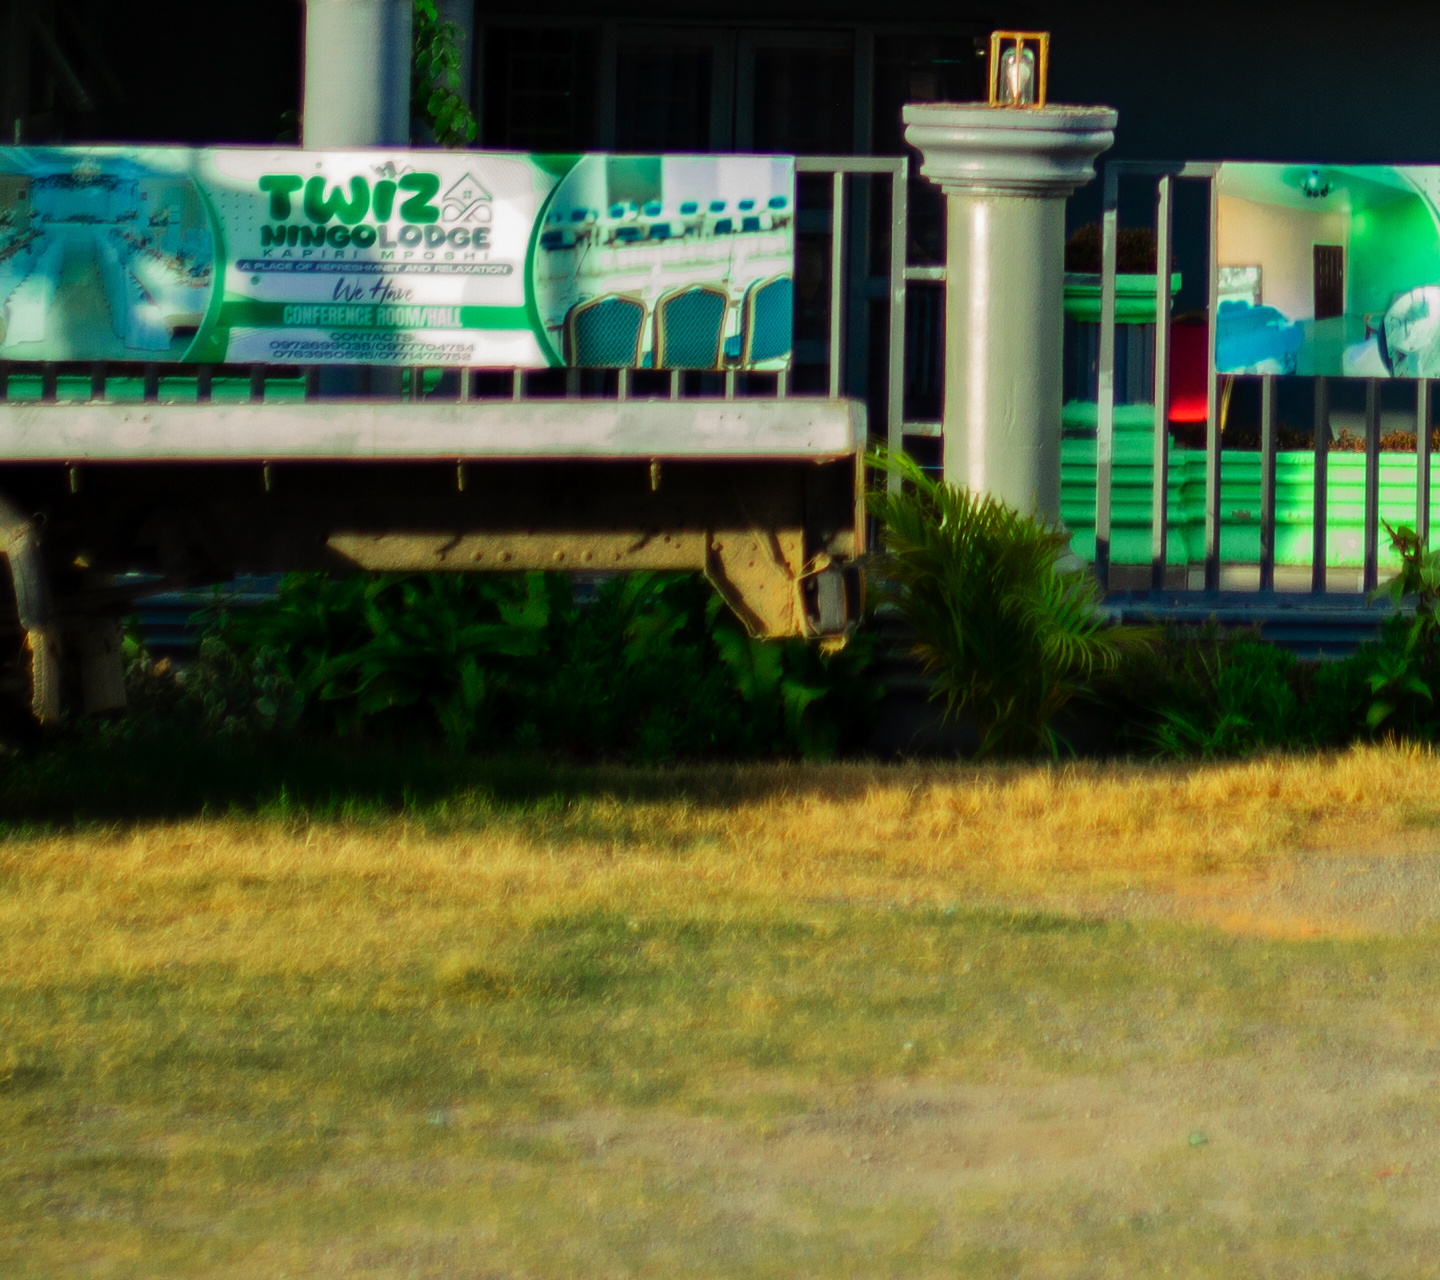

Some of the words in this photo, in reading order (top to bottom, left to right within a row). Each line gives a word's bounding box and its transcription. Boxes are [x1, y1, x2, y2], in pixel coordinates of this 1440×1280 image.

[263, 249, 358, 259] KAPIRI
[381, 251, 488, 260] MPOSHI
[254, 263, 293, 271] PLACE
[405, 265, 431, 273] AND
[434, 265, 509, 275] RELAXATION
[333, 277, 364, 301] We
[369, 276, 414, 304] Have
[283, 305, 373, 326] CONFERENCE
[376, 307, 463, 328] ROOM/HALL
